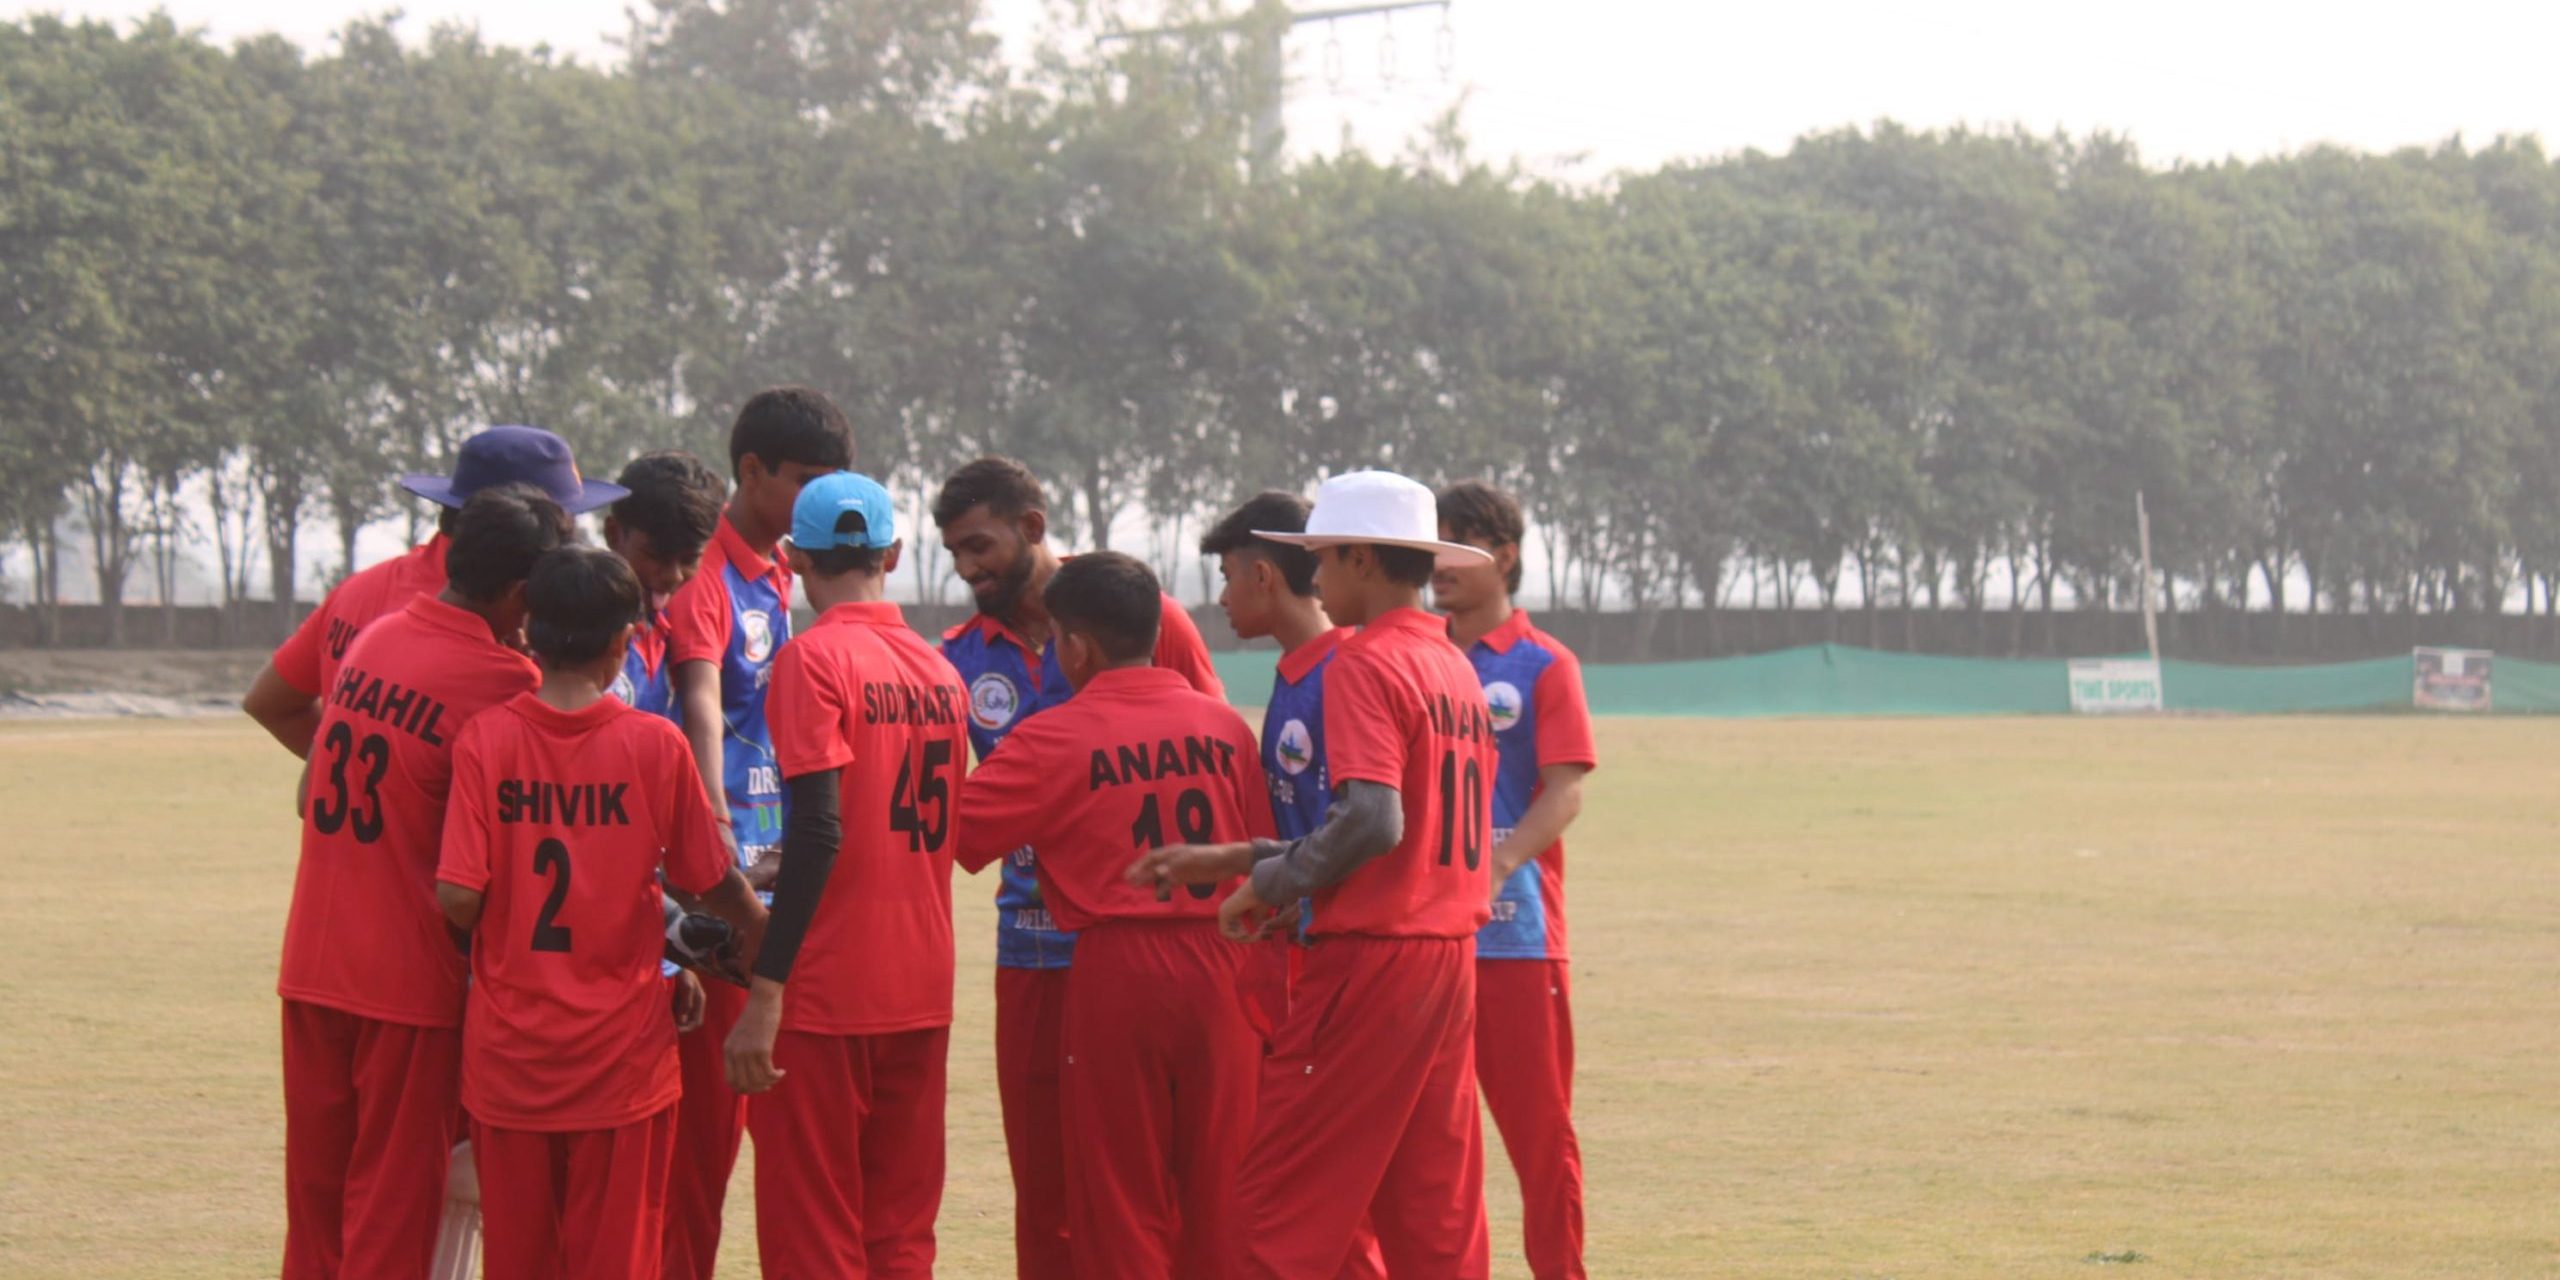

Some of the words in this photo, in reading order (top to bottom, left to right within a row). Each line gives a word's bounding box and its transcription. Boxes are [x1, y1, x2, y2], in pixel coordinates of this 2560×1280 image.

[313, 720, 389, 844] 33
[497, 780, 629, 827] SHIVIK
[890, 739, 952, 853] 45
[1090, 735, 1234, 791] ANANT
[1439, 750, 1481, 872] 10
[531, 838, 572, 953] 2
